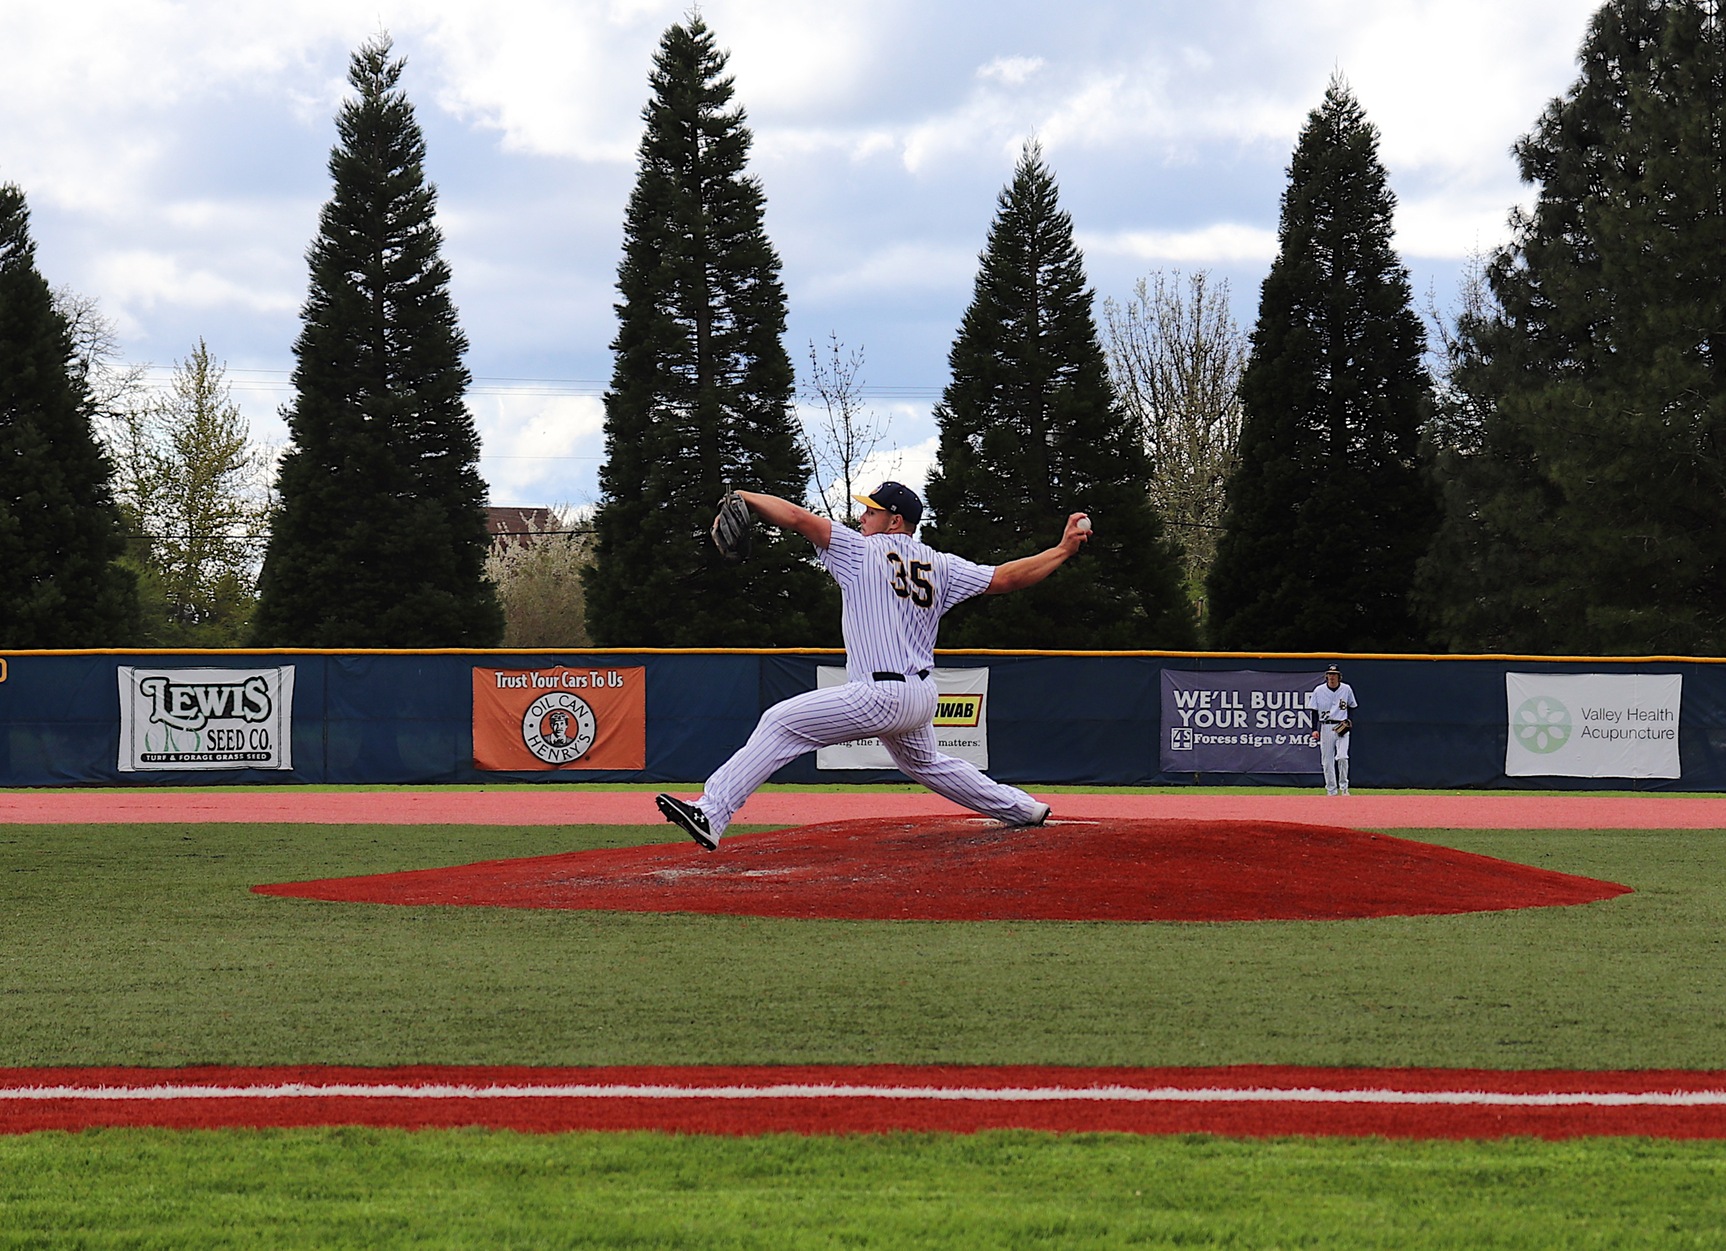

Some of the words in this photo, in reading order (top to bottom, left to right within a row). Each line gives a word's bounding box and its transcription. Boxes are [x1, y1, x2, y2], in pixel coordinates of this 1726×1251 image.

[887, 552, 934, 609] 35
[495, 672, 528, 688] Trust
[530, 672, 559, 688] Your
[561, 671, 587, 688] Cars
[589, 671, 604, 687] To
[607, 671, 623, 687] Us
[140, 676, 271, 731] LEWIS
[531, 697, 554, 717] OIL
[559, 695, 589, 718] CAN
[1174, 691, 1244, 709] WE'LL
[1178, 710, 1249, 728] YOUR
[1256, 710, 1313, 729] SIGN
[1581, 708, 1623, 724] Valley
[1627, 708, 1674, 722] Health
[207, 728, 245, 751] SEED
[250, 728, 272, 750] CO.
[856, 738, 873, 747] the
[1193, 733, 1237, 744] Foress
[1240, 733, 1272, 747] Sign
[1275, 734, 1287, 745] &
[1289, 734, 1320, 748] Mfg.
[1581, 726, 1675, 742] Acupuncture
[528, 734, 590, 761] HENRY'S
[179, 753, 213, 761] FORAGE
[216, 753, 245, 761] GRASS
